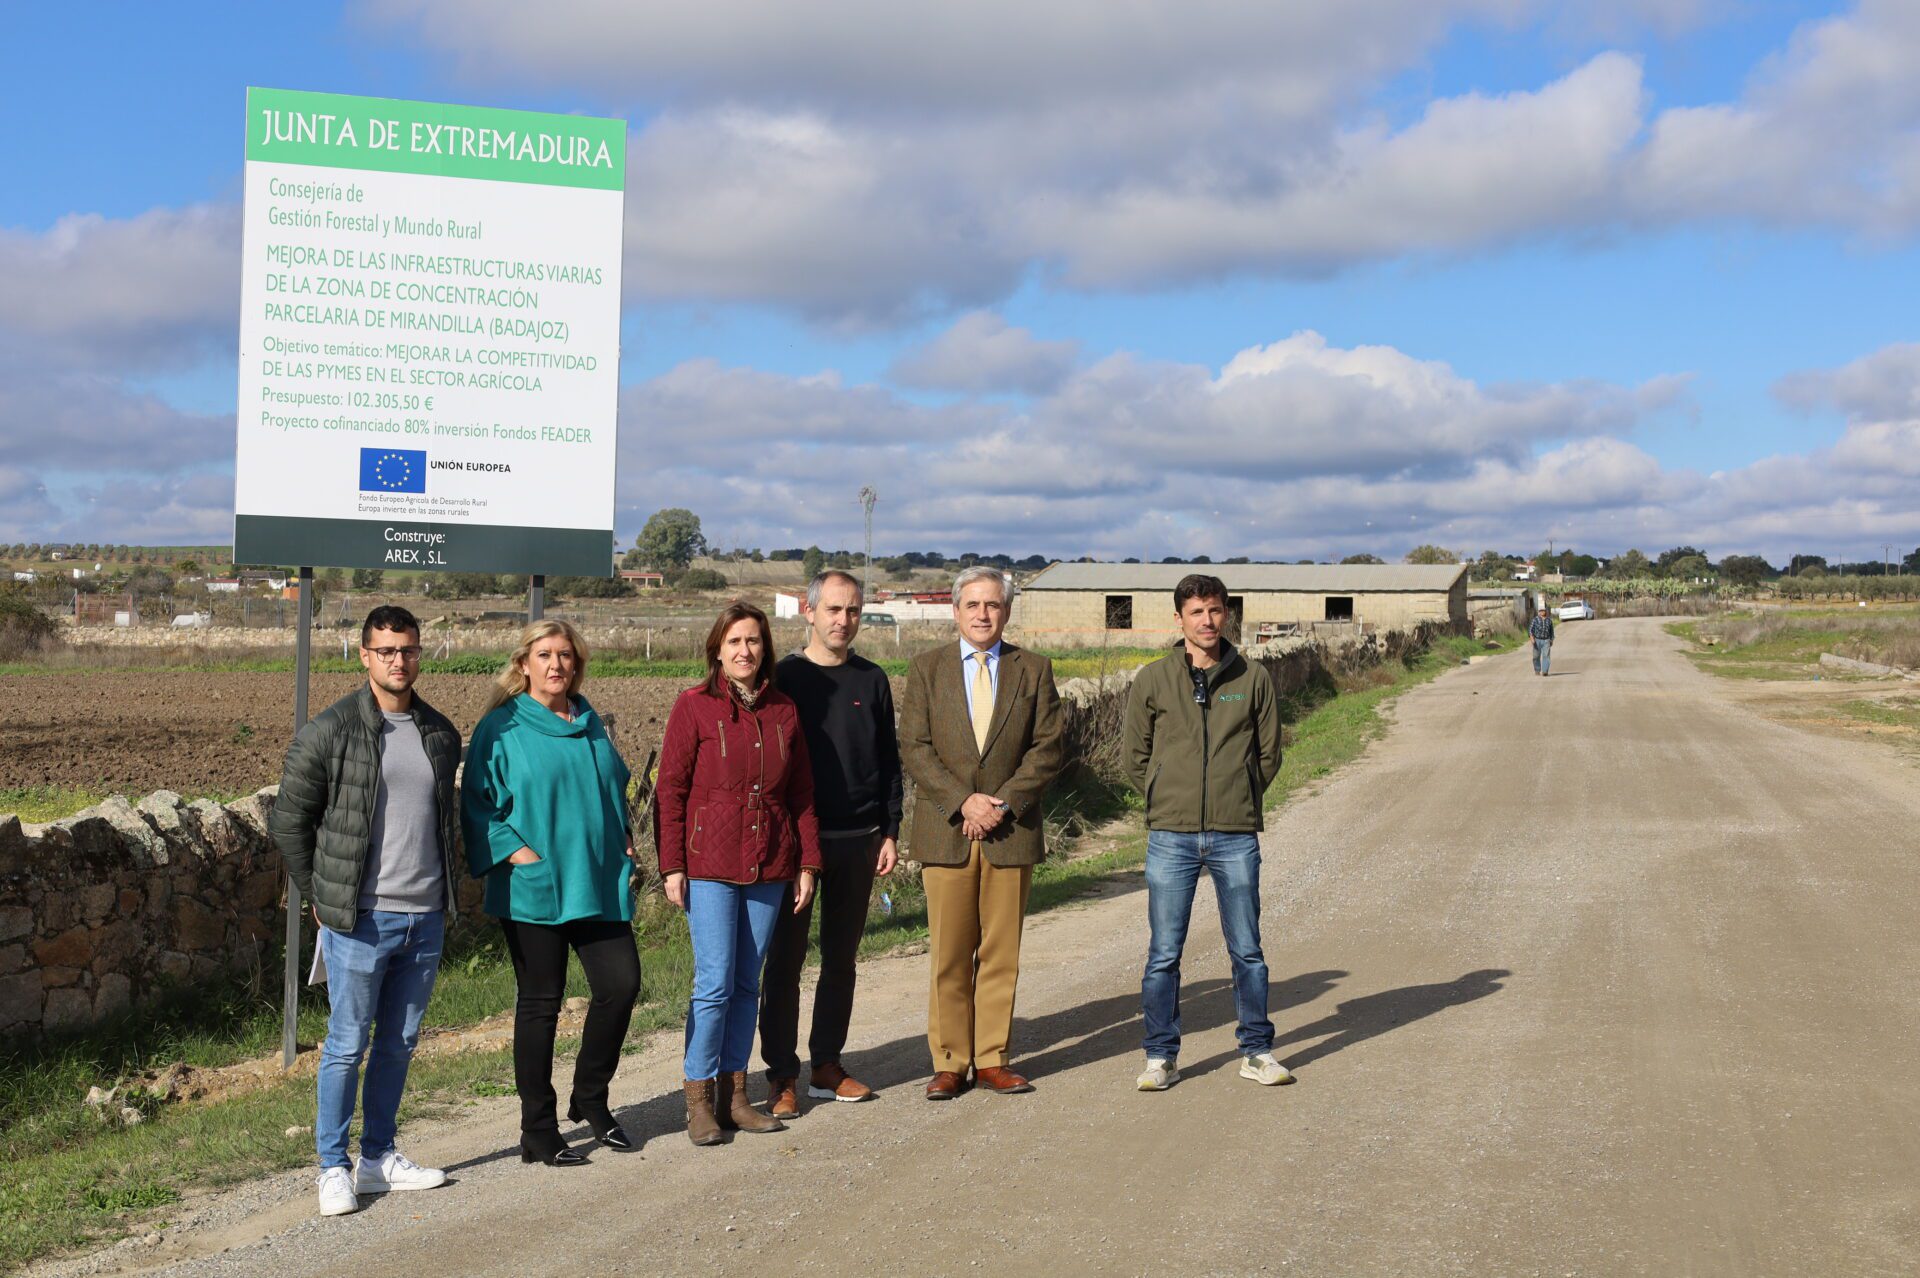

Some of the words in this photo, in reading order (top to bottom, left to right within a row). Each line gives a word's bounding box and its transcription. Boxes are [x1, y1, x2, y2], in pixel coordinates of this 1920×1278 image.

[262, 110, 358, 147] JUNTA
[369, 119, 400, 151] DE
[411, 122, 613, 169] EXTREMADURA
[269, 177, 342, 205] Consejería
[346, 183, 364, 203] de
[269, 206, 321, 228] Gestión
[326, 211, 379, 232] Forestal
[382, 220, 390, 239] y
[395, 216, 443, 237] Mundo
[447, 220, 482, 240] Rural
[267, 245, 329, 268] MEJORA
[334, 249, 354, 268] DE
[359, 251, 386, 270] LAS
[391, 253, 544, 281] INFRAESTRUCTURAS
[546, 265, 602, 286] VIARIAS
[266, 274, 287, 293] DE
[292, 276, 312, 294] LA
[316, 277, 366, 298] ZONA
[371, 281, 391, 300] DE
[396, 283, 538, 309] CONCENTRACIÓN
[265, 303, 360, 327] PARCELARIA
[365, 309, 386, 328] DE
[390, 311, 485, 334] MIRANDILLA
[490, 318, 569, 344] (BADAJOZ)
[263, 336, 319, 356] Objetivo
[324, 341, 383, 358] temático:
[386, 344, 451, 364] MEJORAR
[455, 348, 473, 364] LA
[477, 349, 597, 371] COMPETITIVIDAD
[263, 361, 282, 377] DE
[287, 362, 313, 378] LAS
[317, 364, 362, 381] PYMES
[366, 367, 386, 383] EN
[391, 368, 406, 384] EL
[410, 369, 466, 387] SECTOR
[468, 371, 543, 392] AGRÍCOLA
[262, 386, 343, 408] Presupuesto:
[348, 392, 420, 411] 102.305,50
[424, 396, 434, 411] €
[262, 411, 319, 432] Proyecto
[323, 415, 401, 433] cofinanciado
[404, 419, 430, 435] 80%
[434, 422, 489, 438] inversión
[494, 424, 537, 441] Fondos
[541, 426, 592, 443] FEADER
[430, 459, 463, 470] UNIÓN
[466, 462, 511, 473] EUROPEA
[358, 503, 381, 513] Europa
[383, 506, 407, 514] invierte
[418, 507, 427, 515] las
[448, 509, 470, 517] rurales
[359, 493, 378, 502] Fondo
[379, 494, 405, 504] Europeo
[431, 497, 438, 505] de
[440, 497, 471, 506] Desarrollo
[472, 498, 488, 507] Rural
[384, 527, 446, 547] Construye:
[385, 549, 420, 564] AREX
